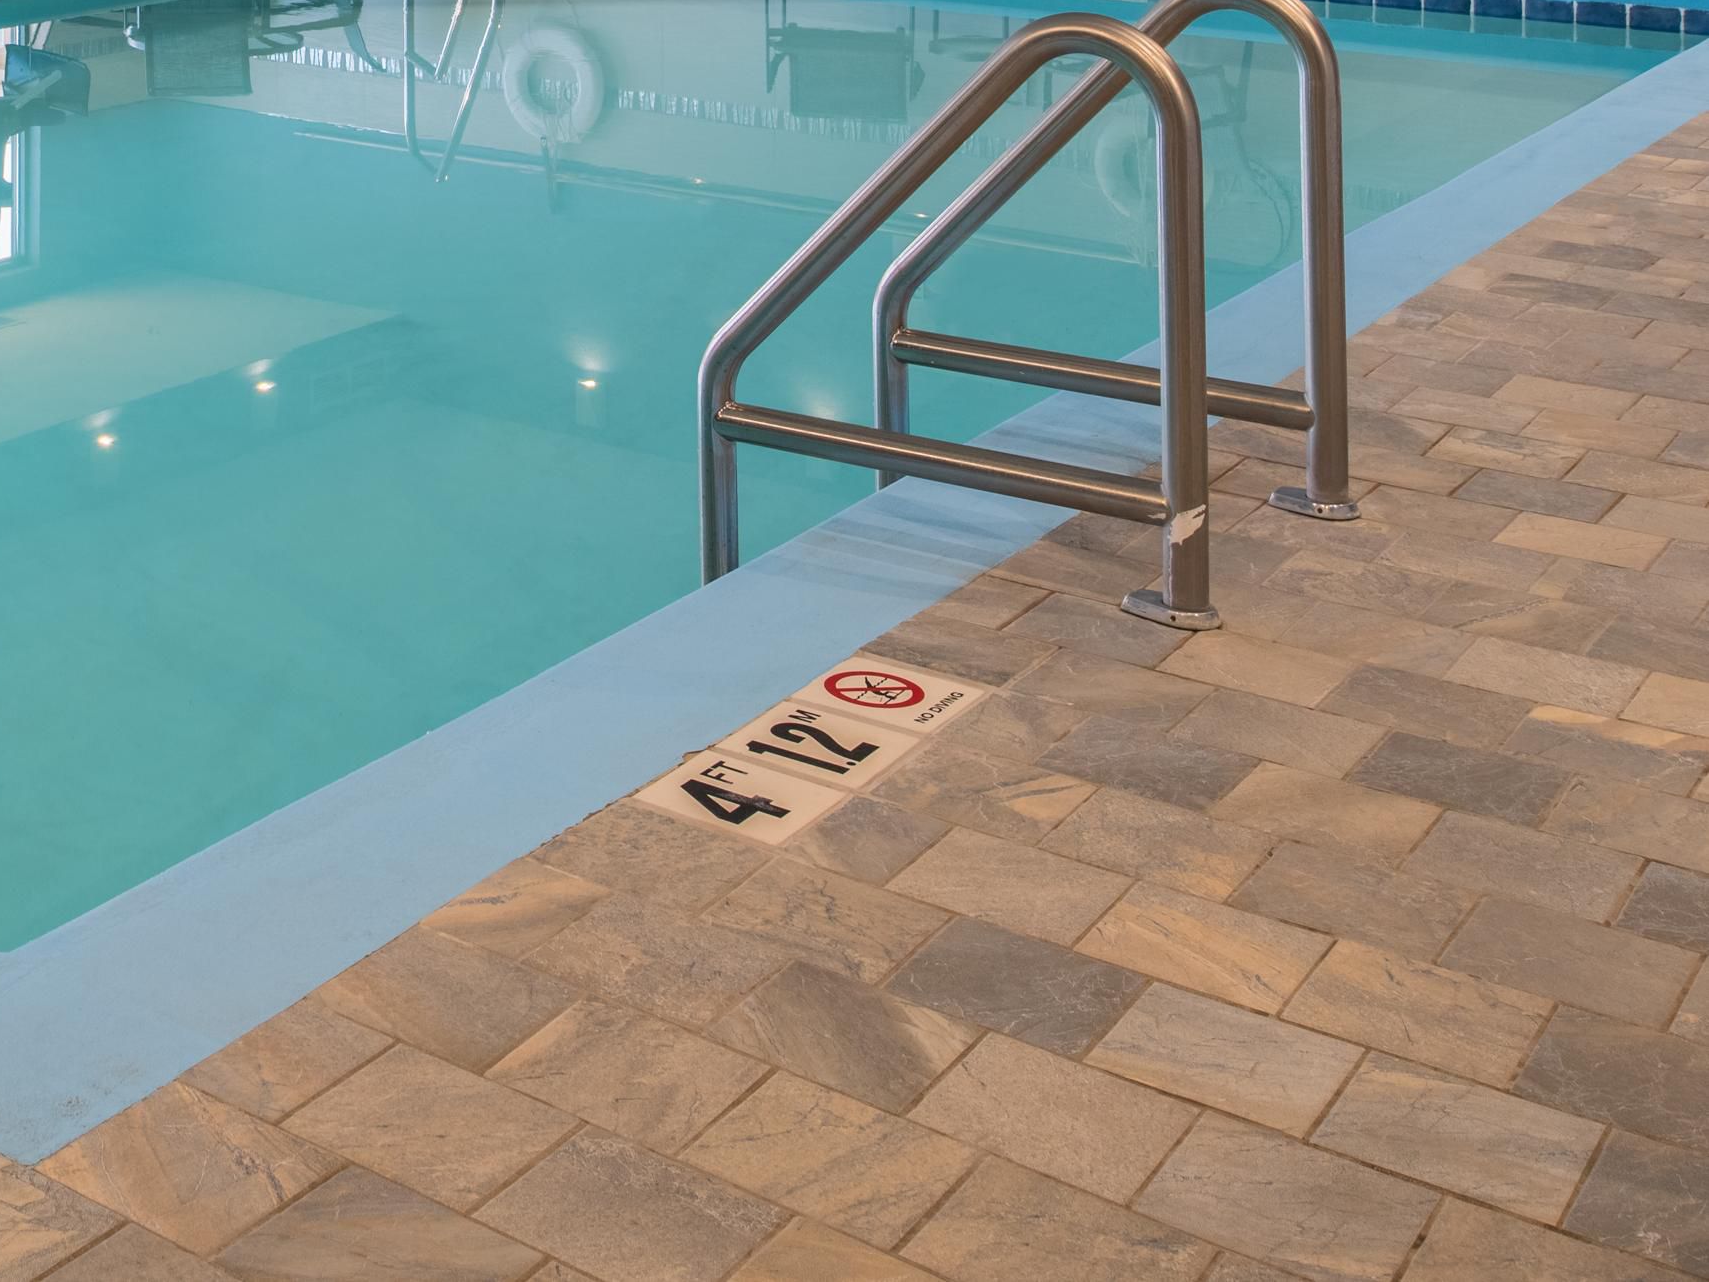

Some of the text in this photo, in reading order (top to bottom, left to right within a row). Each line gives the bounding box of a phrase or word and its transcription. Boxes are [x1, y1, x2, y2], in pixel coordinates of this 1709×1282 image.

[788, 709, 822, 724] M
[914, 691, 964, 724] NO DIVING
[681, 760, 791, 825] 4 FT
